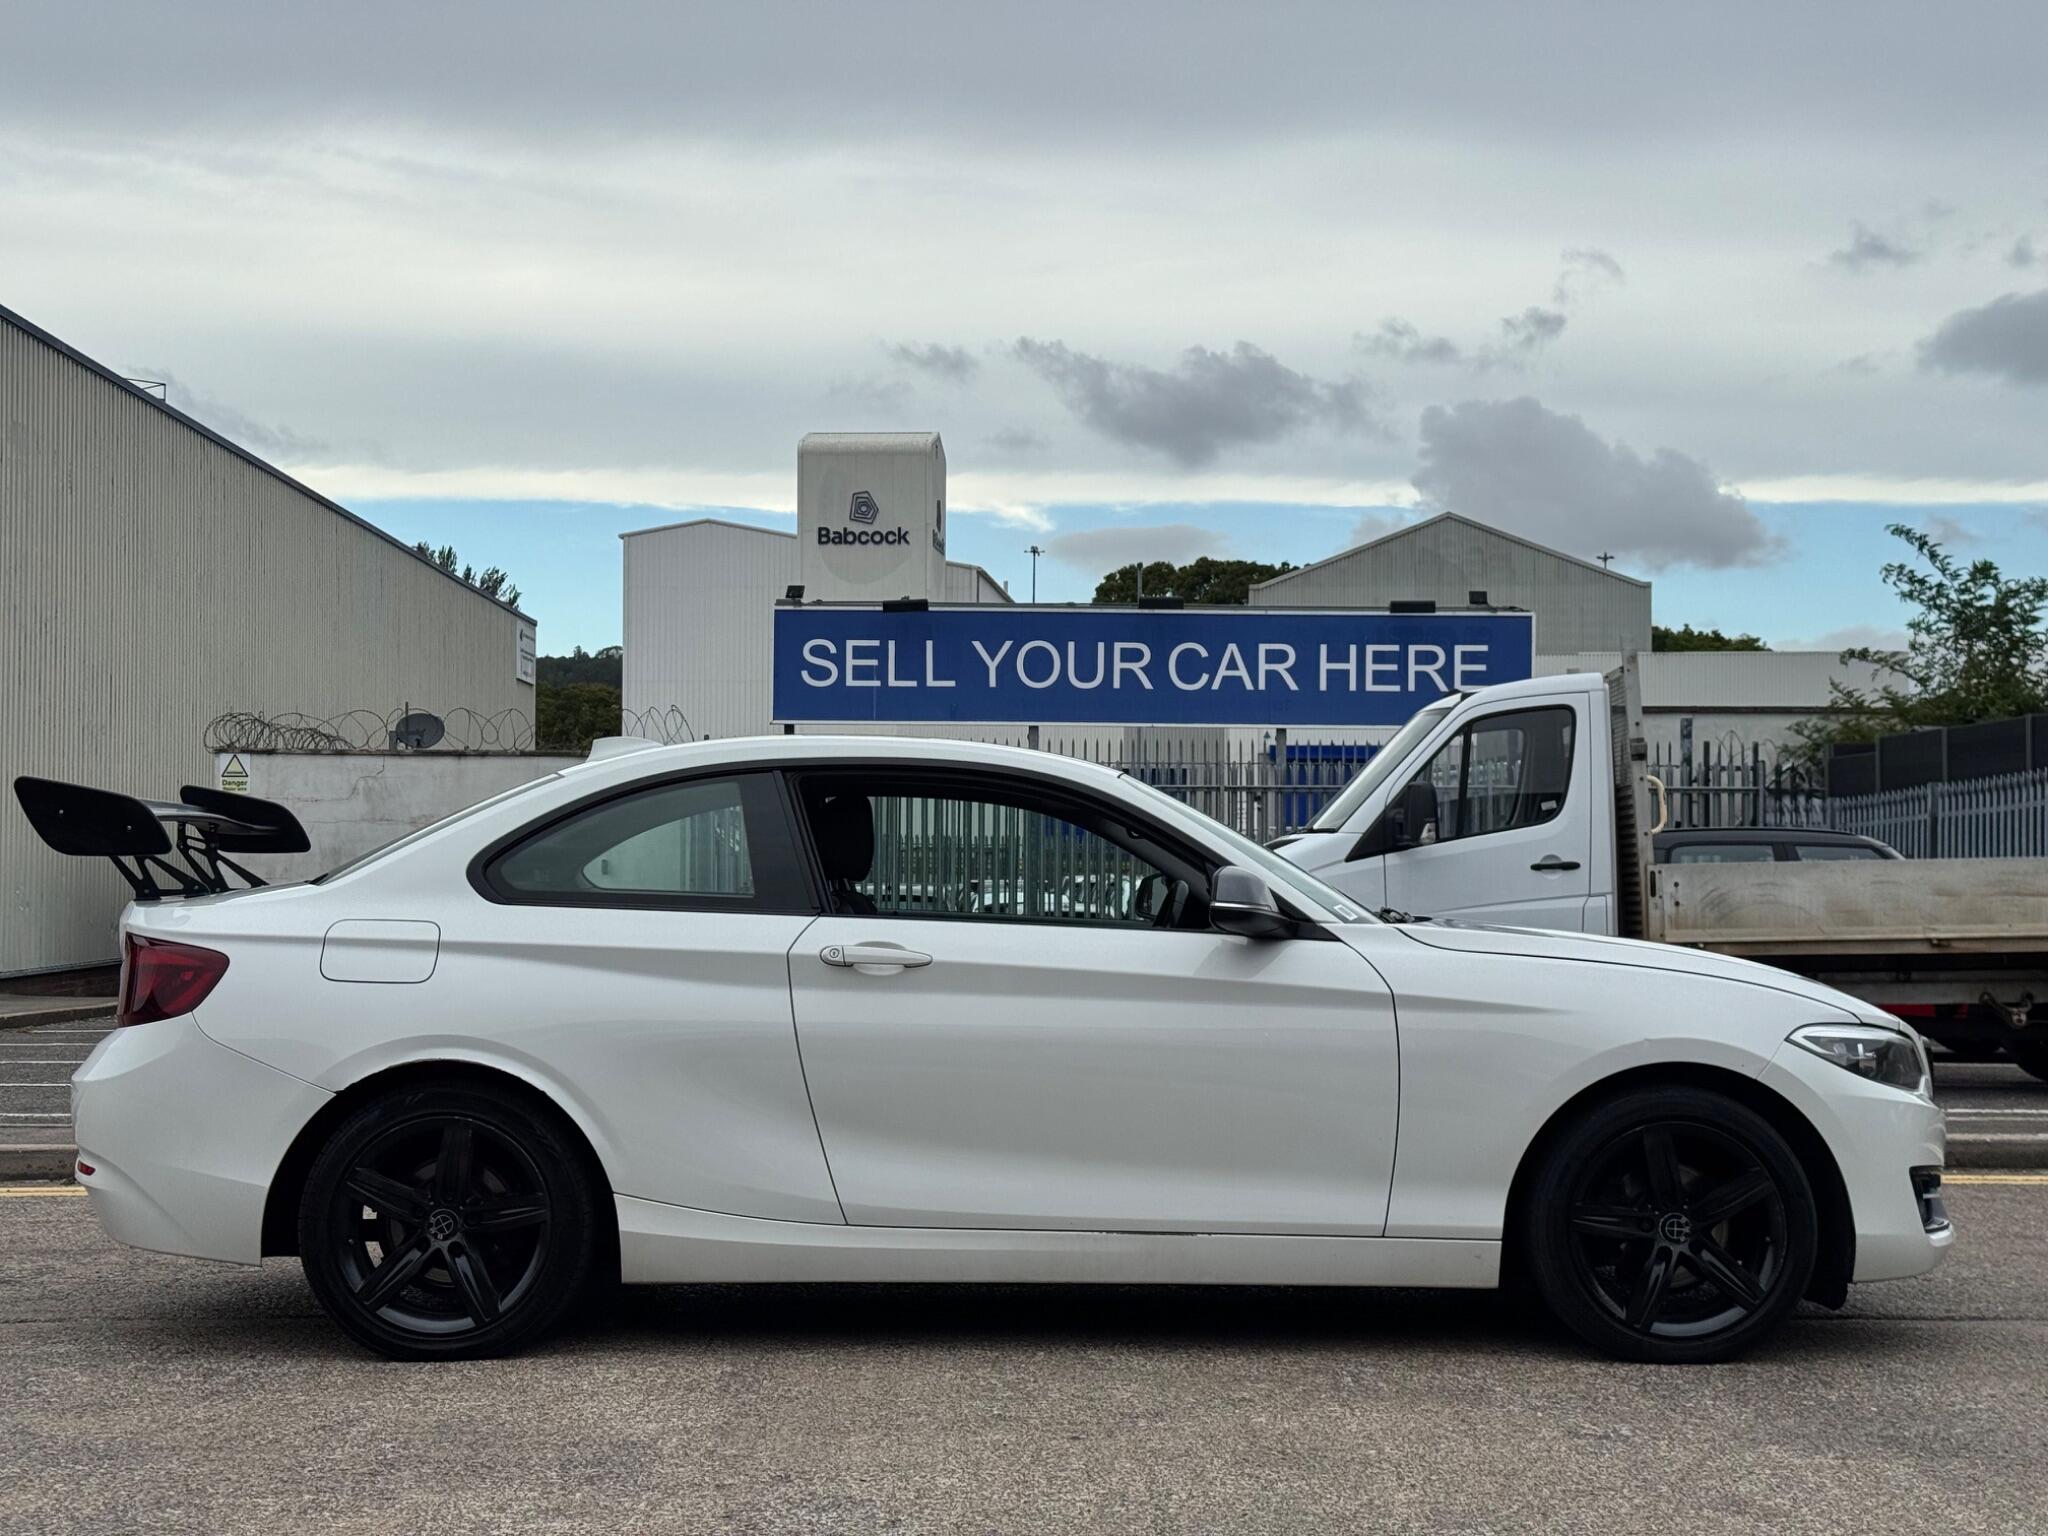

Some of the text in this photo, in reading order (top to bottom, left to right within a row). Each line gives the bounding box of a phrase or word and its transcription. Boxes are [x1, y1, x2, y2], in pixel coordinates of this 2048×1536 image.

[817, 526, 911, 546] Babcock
[801, 638, 1489, 692] SELL YOUR CAR HERE
[222, 779, 248, 787] Danger
